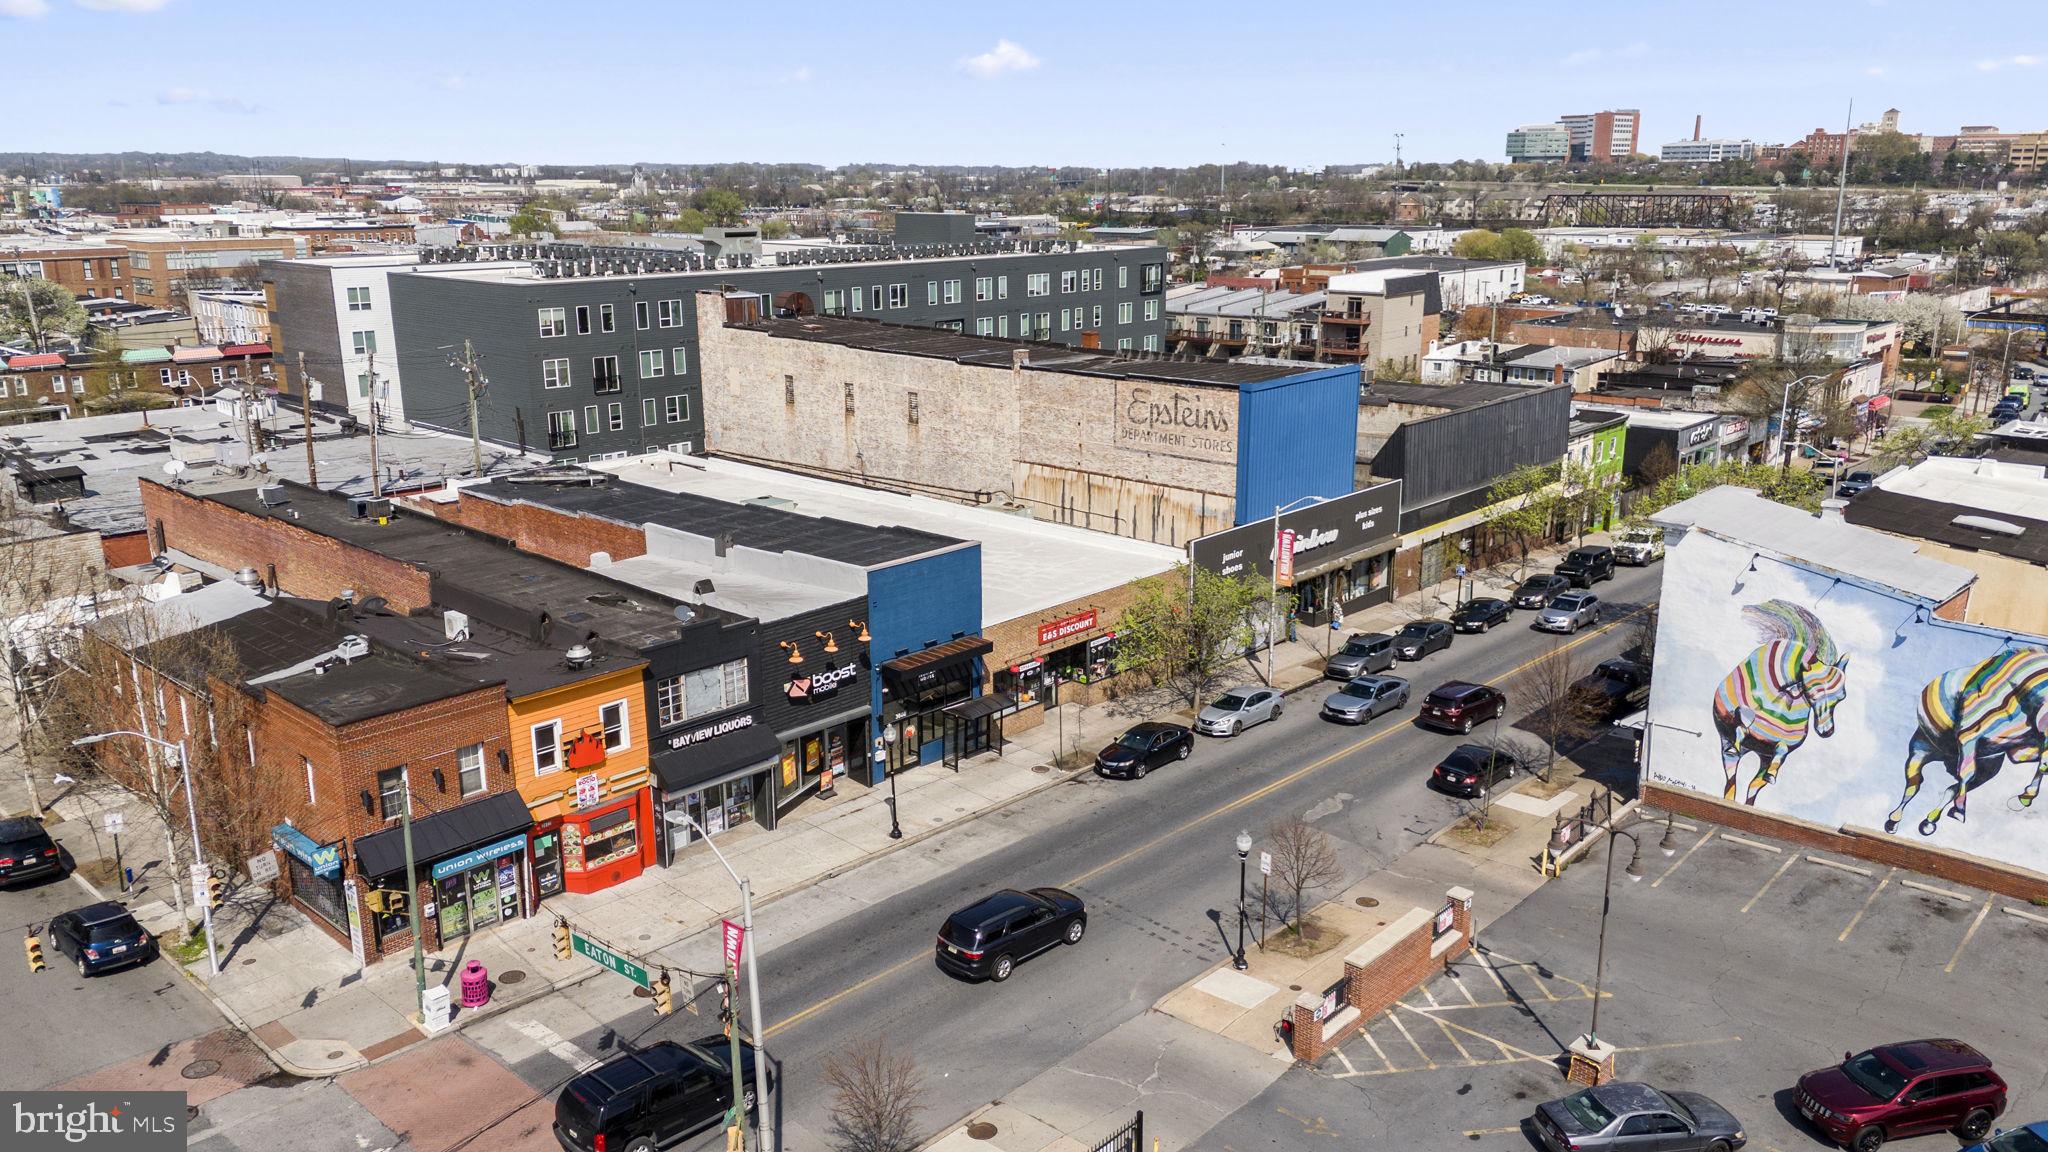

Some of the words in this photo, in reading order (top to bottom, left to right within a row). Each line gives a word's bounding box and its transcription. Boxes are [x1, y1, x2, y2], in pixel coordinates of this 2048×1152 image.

[1675, 333, 1743, 348] Walgreens
[1127, 387, 1229, 433] Epsteins
[1122, 427, 1186, 447] DEPARTMENT
[1191, 437, 1233, 453] STORES
[1355, 510, 1367, 522] plus
[1368, 505, 1383, 517] sizes
[1362, 519, 1375, 531] kids
[1222, 549, 1243, 564] junior
[1222, 563, 1243, 576] shoes
[1042, 630, 1058, 642] E&S
[1059, 617, 1094, 636] DISCOUNT
[812, 662, 857, 688] boost
[813, 681, 838, 695] mobile
[672, 724, 713, 749] BAYVIEW
[714, 715, 753, 736] LIQUORS
[437, 857, 473, 874] union
[475, 839, 524, 861] wireless
[583, 942, 617, 969] EATON
[623, 963, 638, 978] ST.
